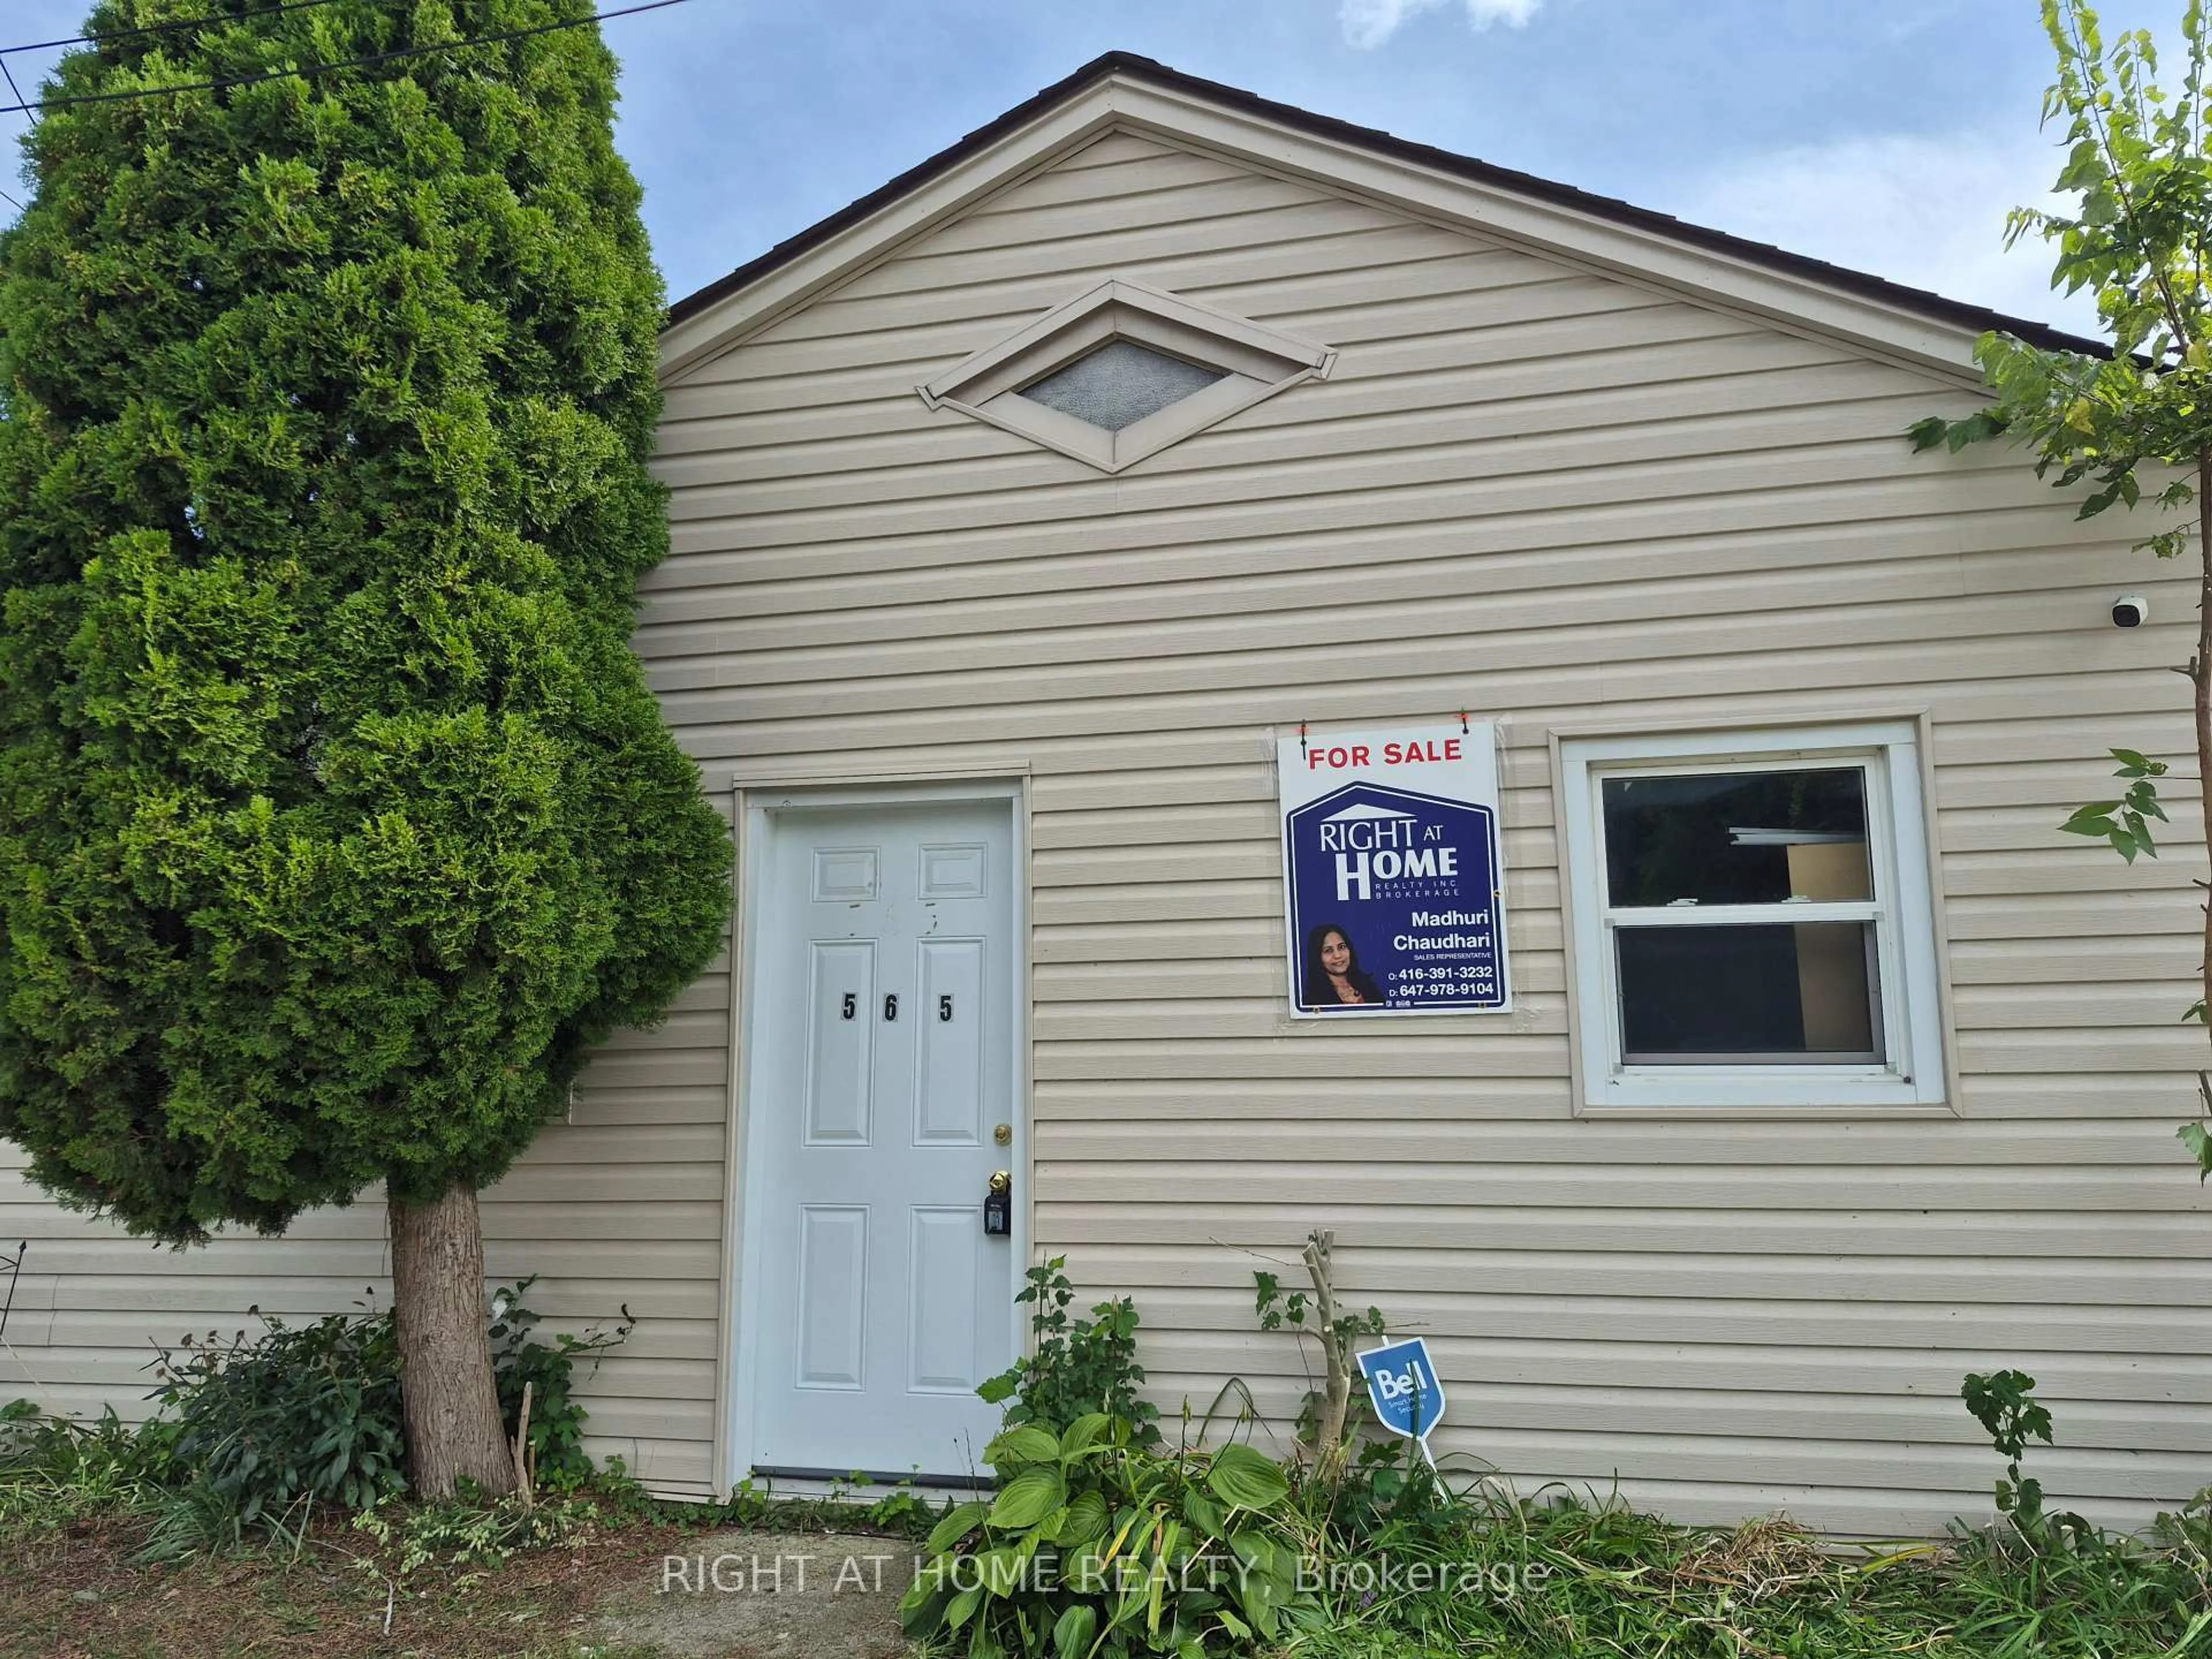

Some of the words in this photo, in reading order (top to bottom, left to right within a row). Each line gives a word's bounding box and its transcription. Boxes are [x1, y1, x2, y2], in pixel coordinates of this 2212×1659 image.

[1309, 747, 1370, 770] FOR
[1384, 738, 1462, 764] SALE
[1320, 819, 1418, 851] RIGHT
[1423, 825, 1444, 841] AT
[1335, 847, 1458, 901] HOME
[1375, 881, 1423, 891] REALTY
[1375, 889, 1460, 900] BROKERAGE
[1411, 909, 1488, 927] Madhuri
[1393, 932, 1490, 950] Chaudhari
[1436, 952, 1493, 960] REPRESENTATIVE
[1399, 966, 1493, 980] 416-391-3232
[1399, 983, 1494, 997] 647-978-9104
[1374, 1361, 1427, 1400] Bell
